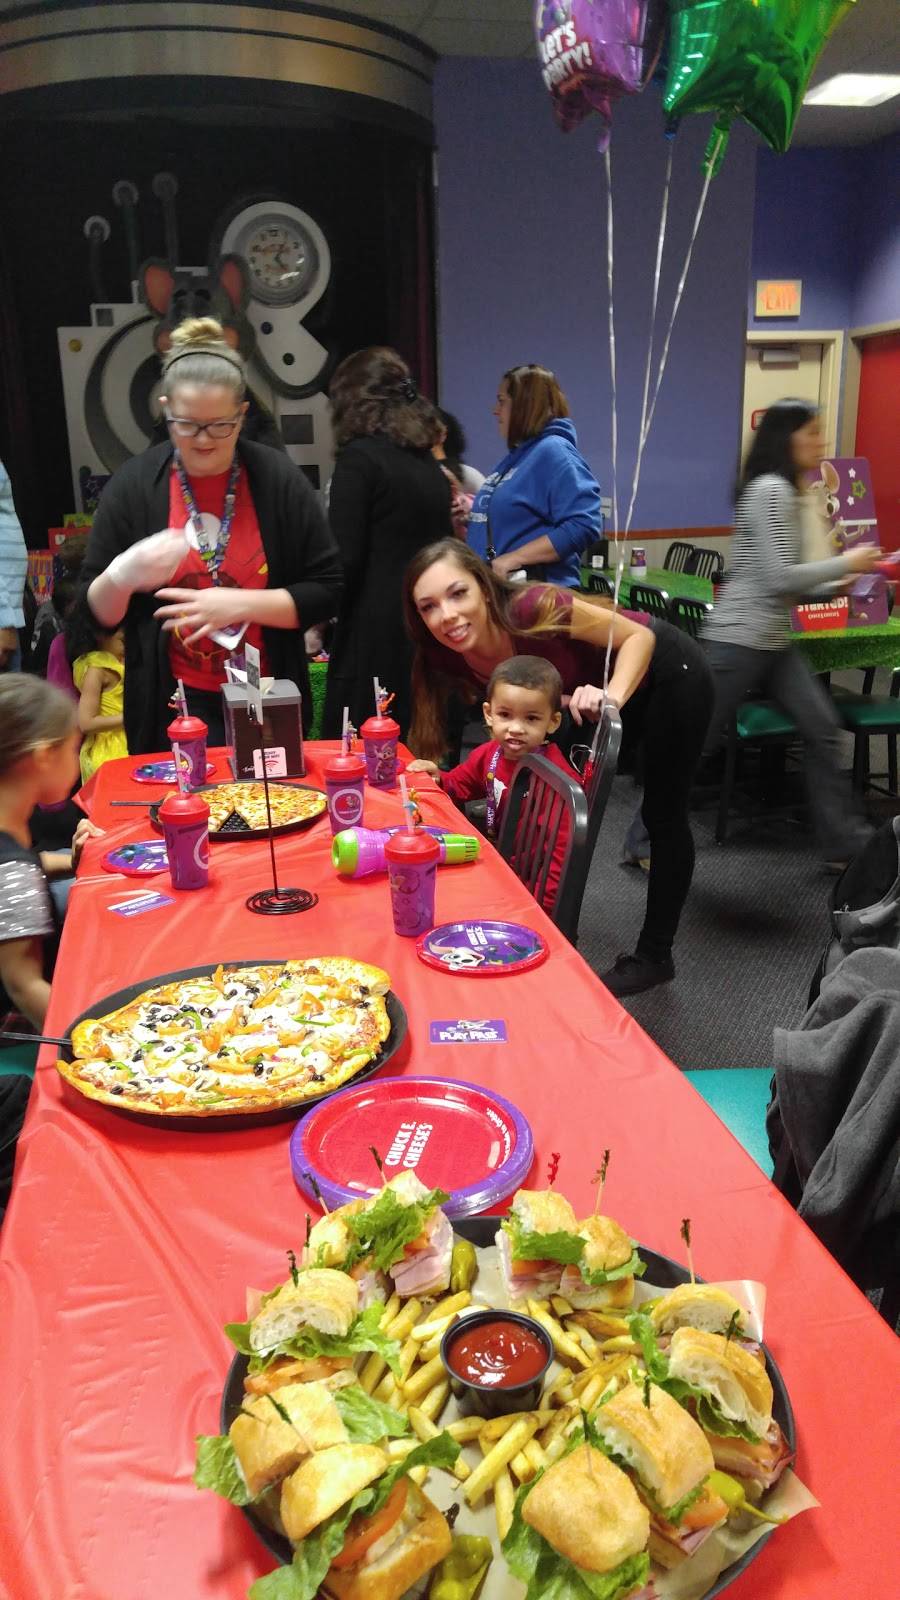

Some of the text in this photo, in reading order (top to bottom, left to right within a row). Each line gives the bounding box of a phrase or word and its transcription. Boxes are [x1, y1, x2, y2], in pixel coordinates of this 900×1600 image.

[540, 21, 577, 64] LET'S
[542, 41, 593, 91] PARTY!
[439, 1031, 498, 1041] PLAY PASS
[384, 1121, 417, 1166] CHUCK E.
[402, 1122, 433, 1168] CHEESE'S
